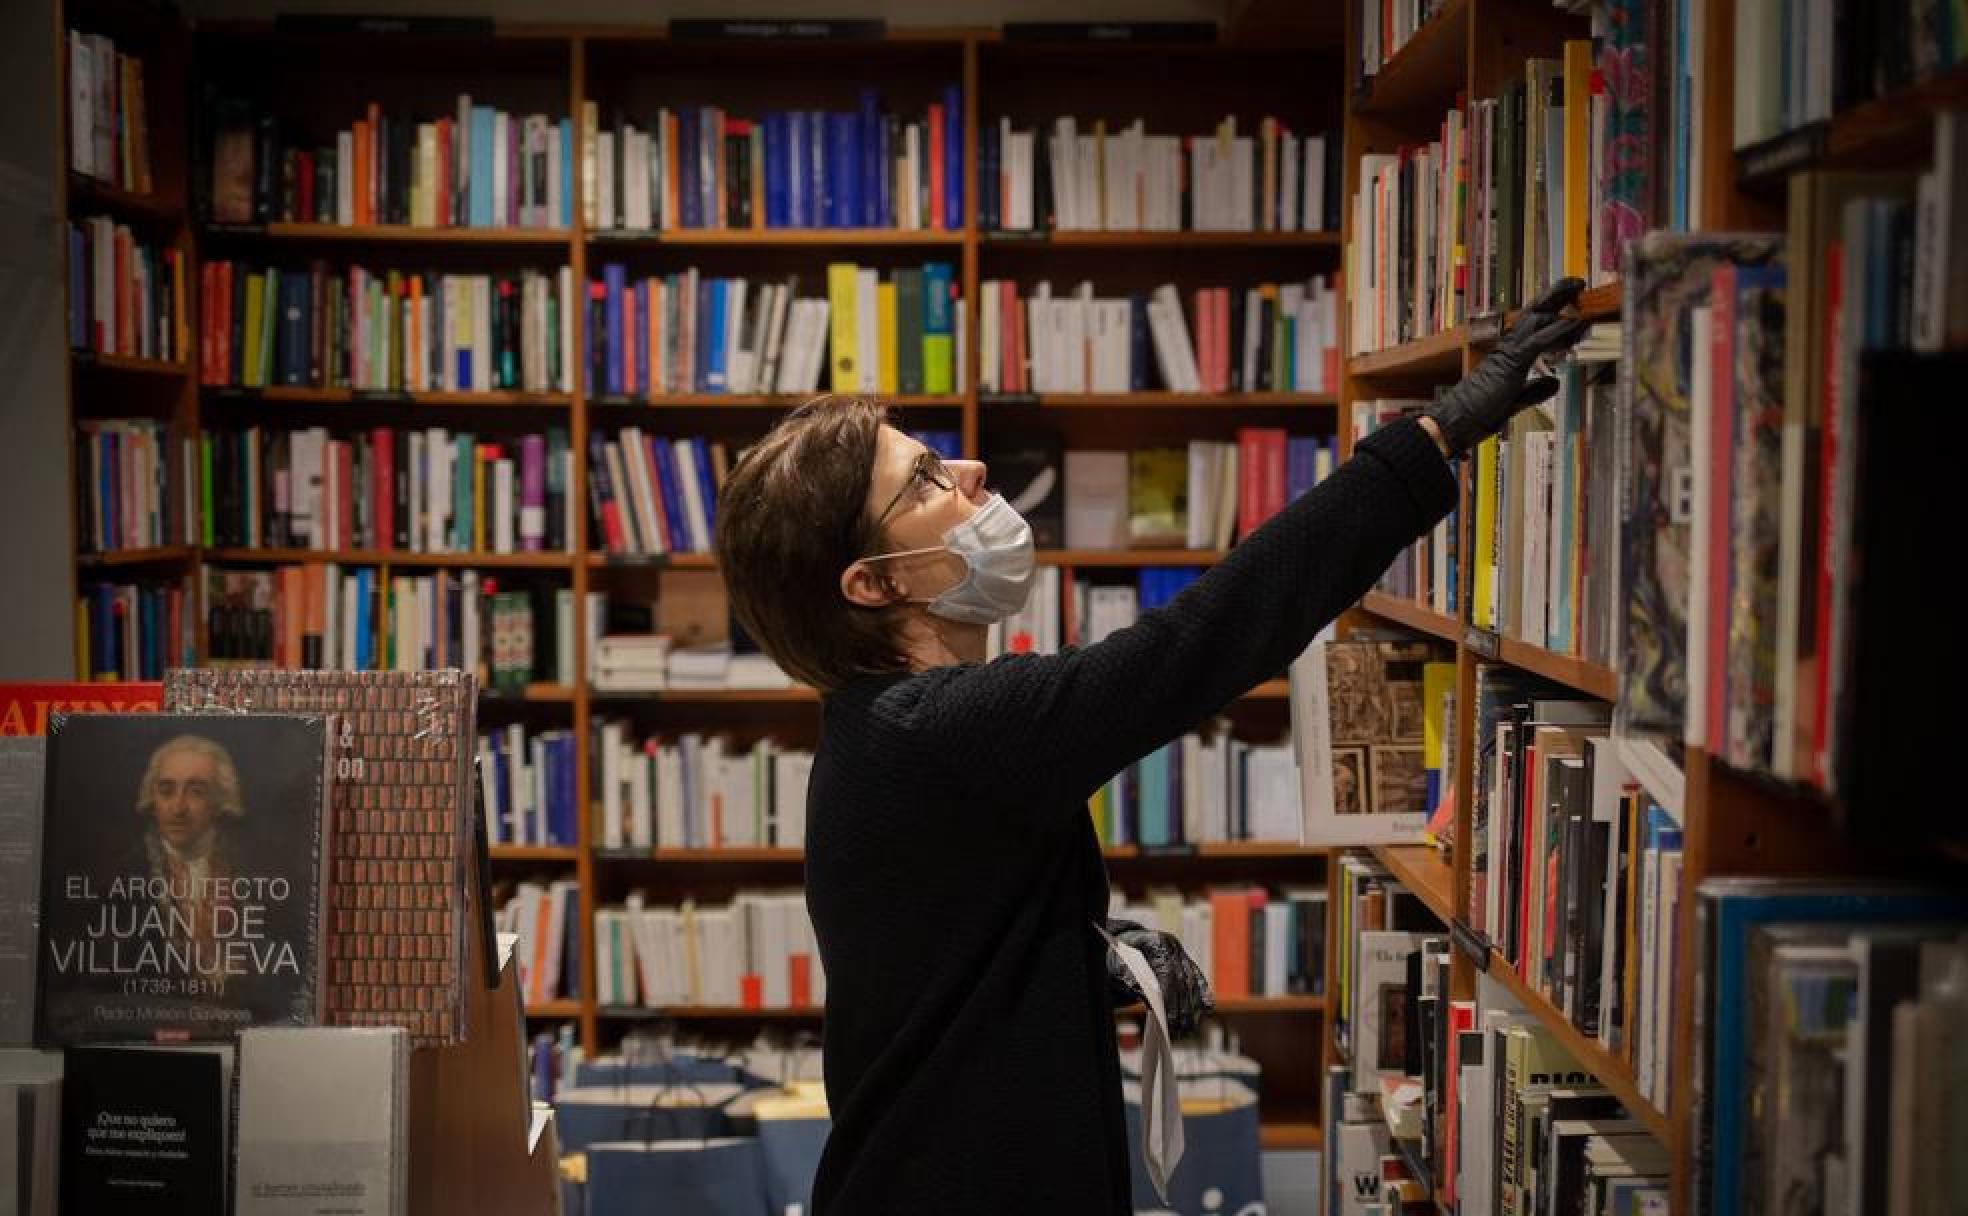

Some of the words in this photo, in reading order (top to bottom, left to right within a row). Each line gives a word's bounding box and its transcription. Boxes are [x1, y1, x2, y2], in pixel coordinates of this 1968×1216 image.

[65, 875, 99, 899] EL
[109, 875, 290, 901] ARQUITECTO
[87, 904, 193, 939] JUAN
[213, 905, 266, 939] DE
[49, 939, 300, 975] VILLANUEVA
[123, 977, 225, 998] (1739-1811)
